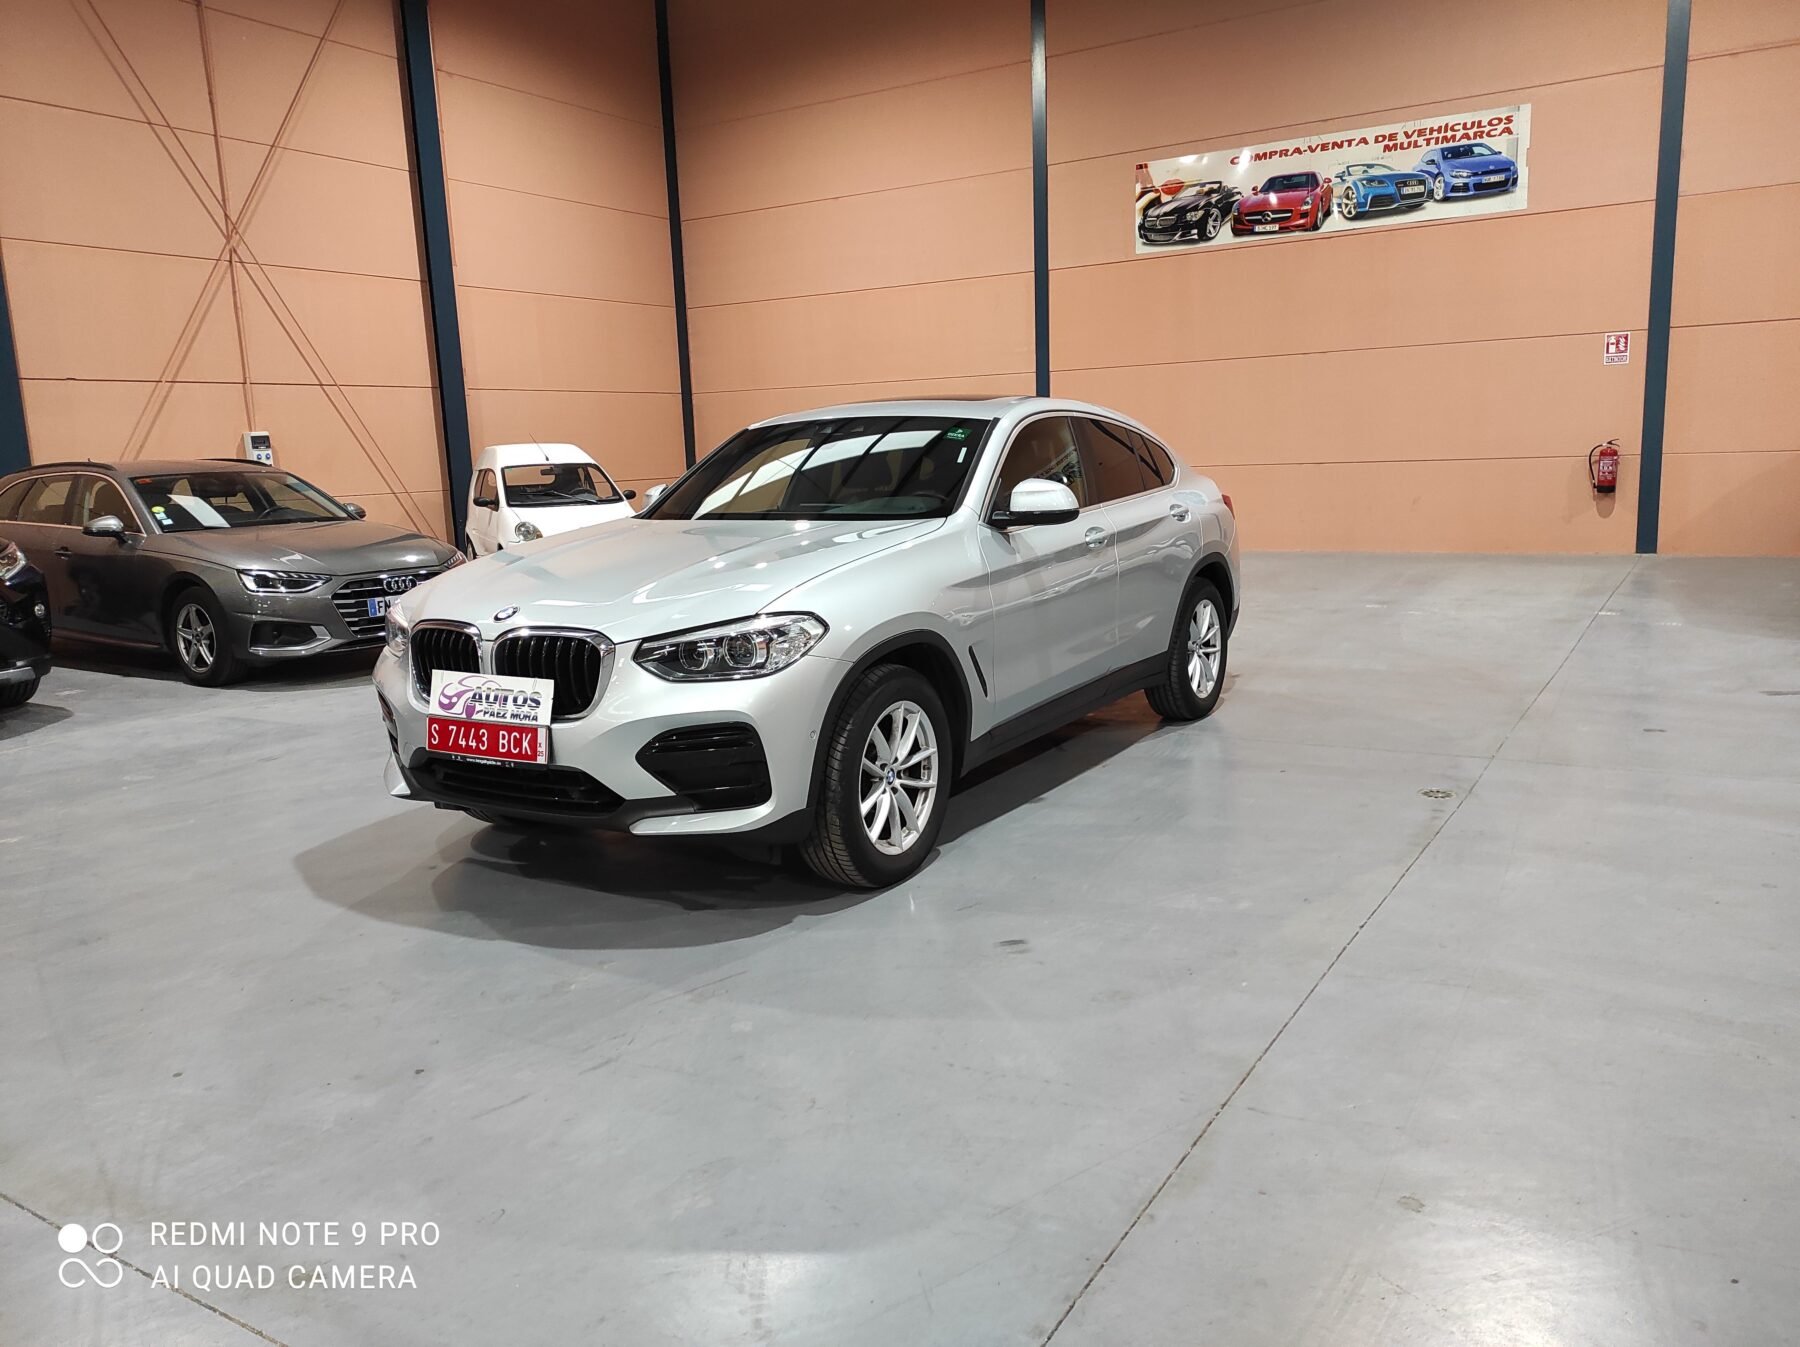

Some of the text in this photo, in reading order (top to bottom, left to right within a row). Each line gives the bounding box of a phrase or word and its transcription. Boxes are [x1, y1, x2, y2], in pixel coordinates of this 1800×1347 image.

[1374, 132, 1399, 144] DE
[1403, 114, 1514, 140] VEHÍCULOS
[1382, 126, 1514, 153] MULTIMARCA
[469, 686, 542, 711] AUTOS
[431, 723, 532, 756] S 7443 BCK
